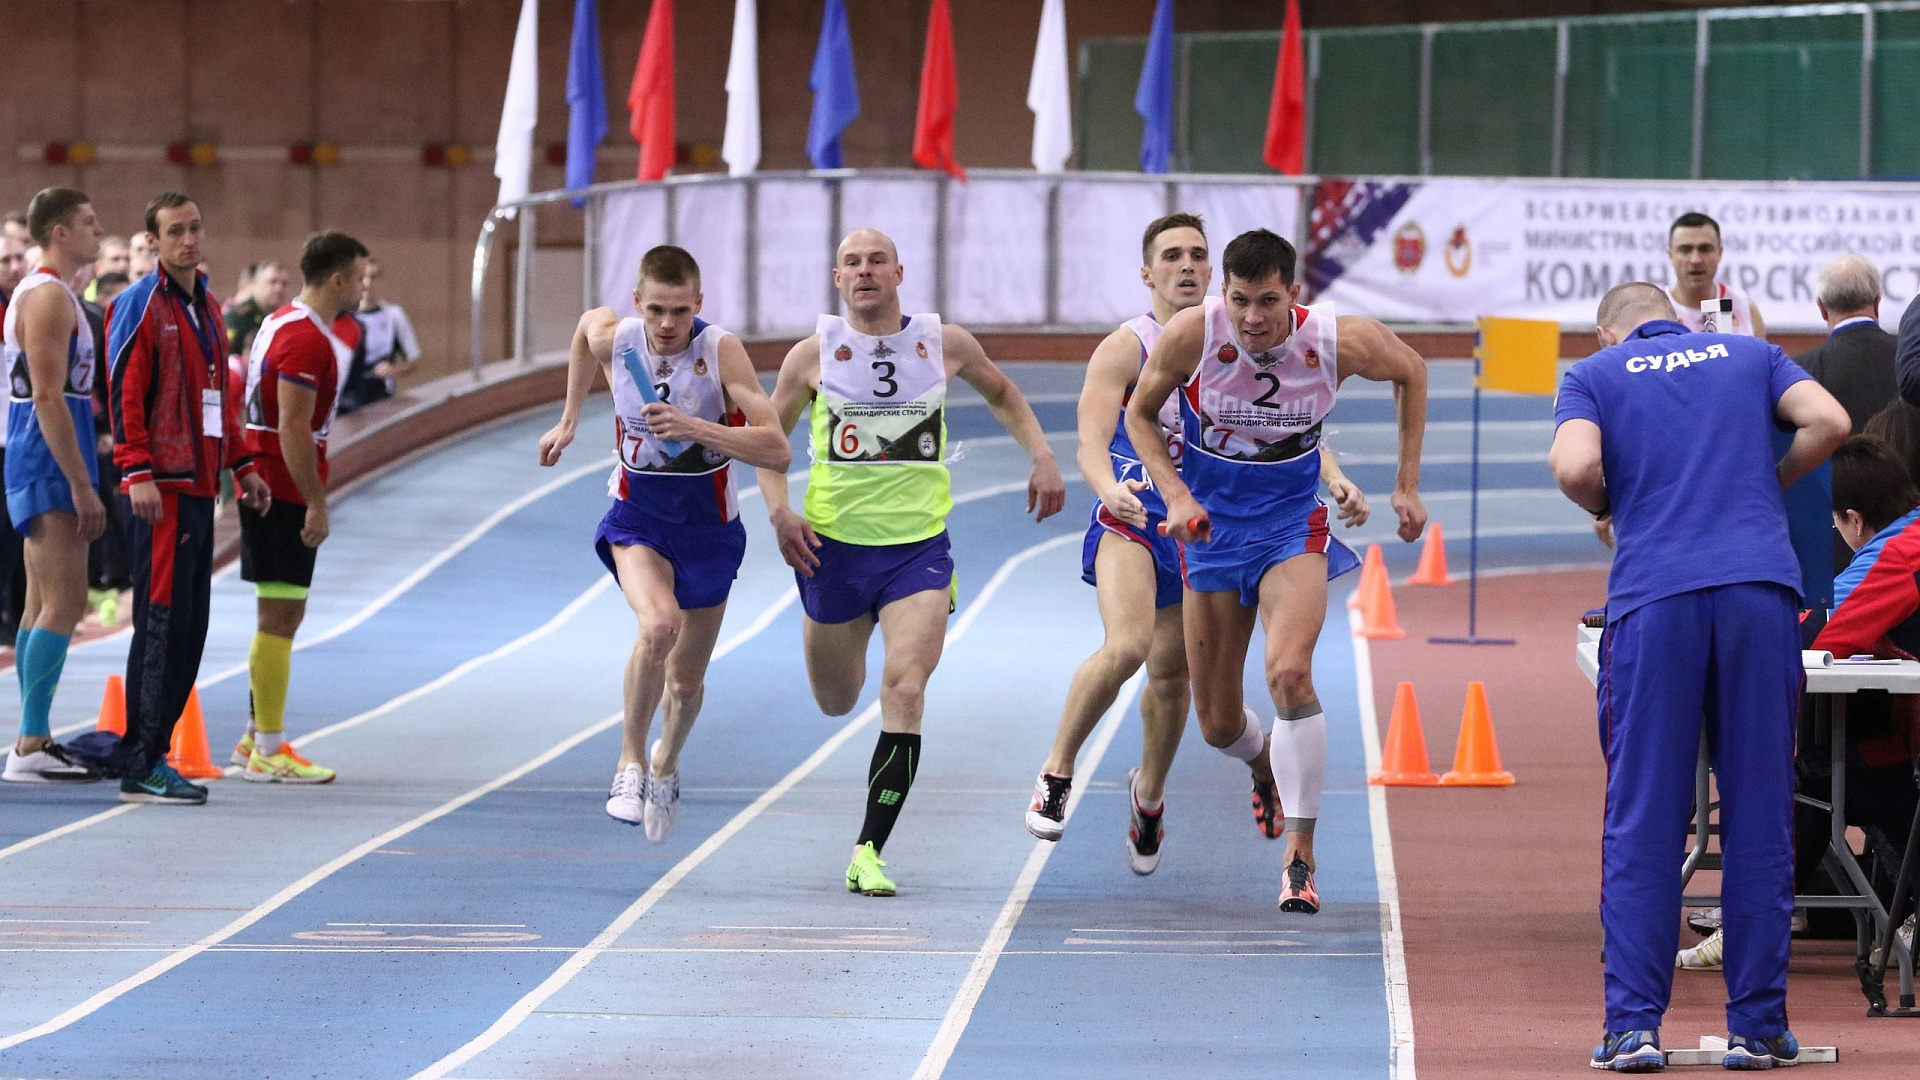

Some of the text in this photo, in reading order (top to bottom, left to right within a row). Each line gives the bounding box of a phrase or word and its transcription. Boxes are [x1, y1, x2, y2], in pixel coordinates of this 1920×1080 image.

[1524, 230, 1636, 250] МИНИСТРА
[1625, 343, 1729, 373] СУДЬЯ
[79, 363, 91, 387] 7
[871, 361, 899, 398] 3
[1252, 372, 1281, 410] 2
[1219, 418, 1312, 427] КОМАНДИРСКИЕ СТАРТЫ
[627, 435, 643, 464] 7
[840, 424, 859, 454] 6
[1167, 433, 1183, 460] 6
[1212, 428, 1235, 451] 7
